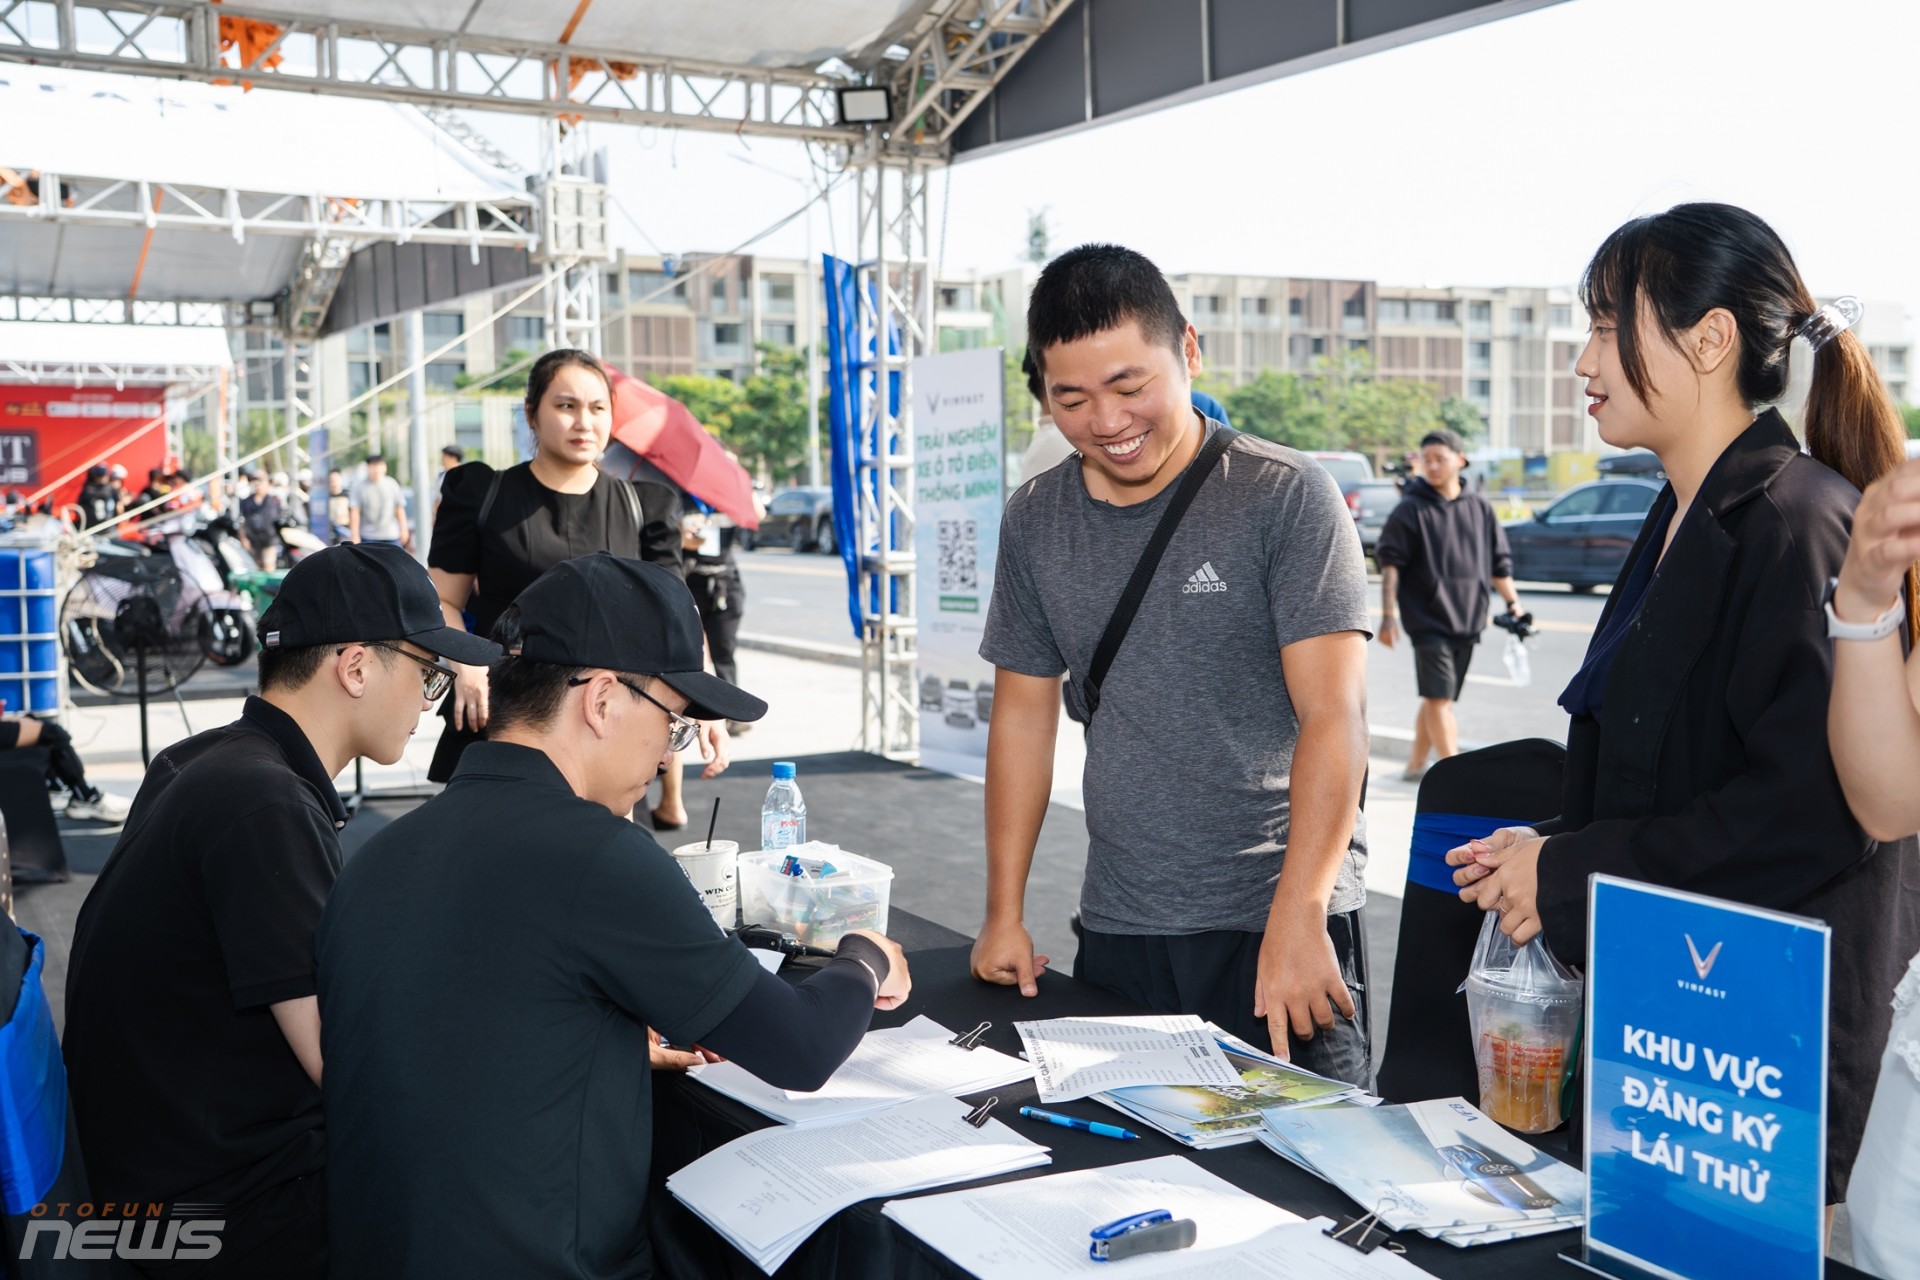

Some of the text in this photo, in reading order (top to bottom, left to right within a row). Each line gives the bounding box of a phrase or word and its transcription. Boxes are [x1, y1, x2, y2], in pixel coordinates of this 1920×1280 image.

[1182, 581, 1228, 594] adidas
[704, 886, 724, 896] WIN
[1677, 979, 1727, 1000] VINFAST
[1623, 1024, 1696, 1072] KHU
[1702, 1047, 1783, 1099] VỰC
[1621, 1075, 1783, 1153] ĐĂNG KÝ
[1631, 1129, 1771, 1204] LÁI THỬ
